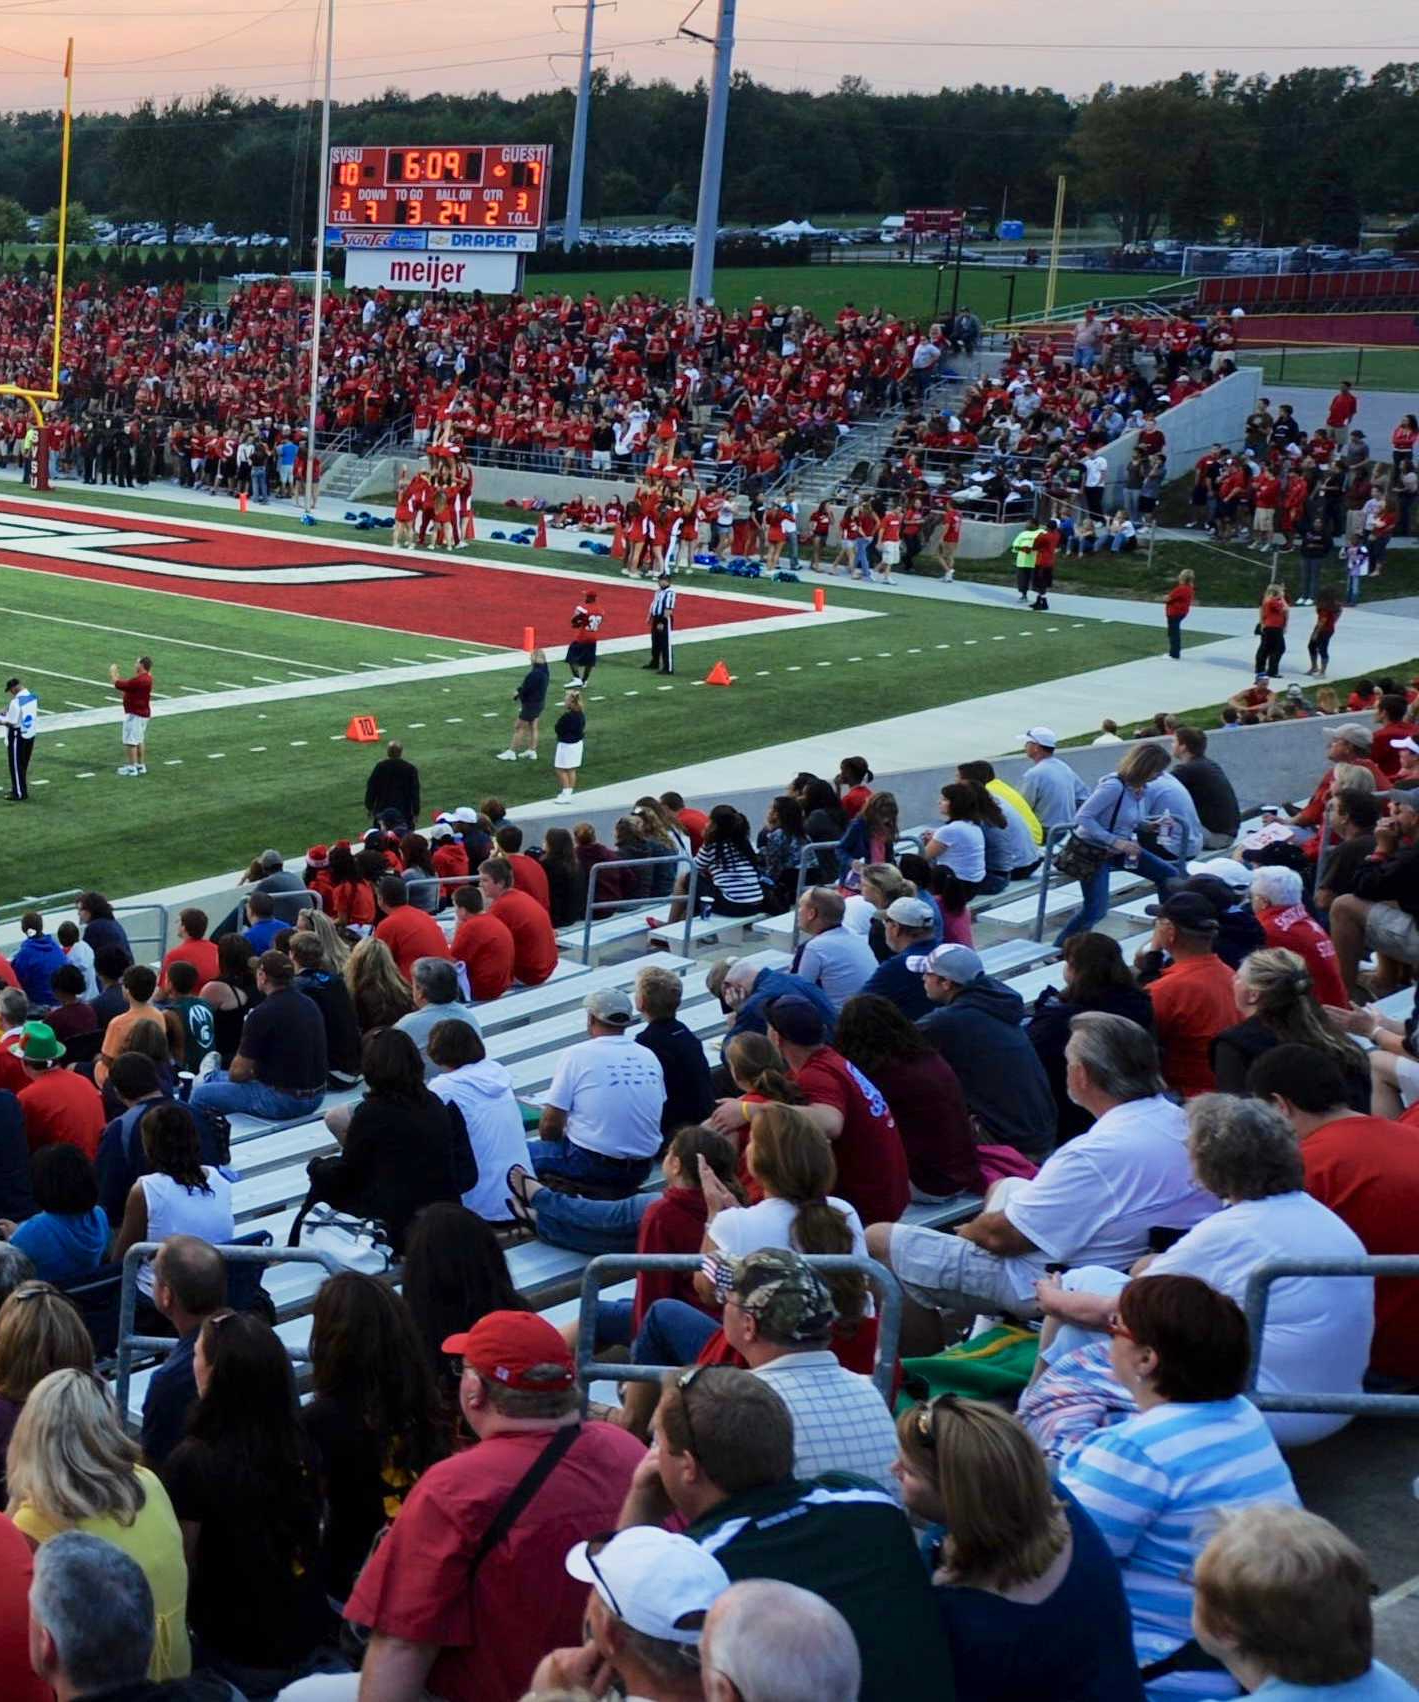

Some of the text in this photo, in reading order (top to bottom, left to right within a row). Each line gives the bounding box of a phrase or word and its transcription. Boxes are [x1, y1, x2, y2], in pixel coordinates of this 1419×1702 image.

[331, 149, 363, 163] SVSU
[405, 151, 460, 179] 6:09
[502, 148, 542, 162] GUEST
[339, 163, 359, 186] 10
[527, 162, 540, 184] 7
[340, 191, 351, 210] 3
[358, 188, 387, 200] DOWN
[394, 188, 423, 200] TO GO
[516, 191, 528, 211] 3
[408, 201, 421, 225] 3
[439, 201, 467, 224] 24
[484, 201, 500, 225] 2
[451, 232, 517, 248] DRAPER
[390, 256, 465, 288] meijer
[359, 719, 375, 736] 10
